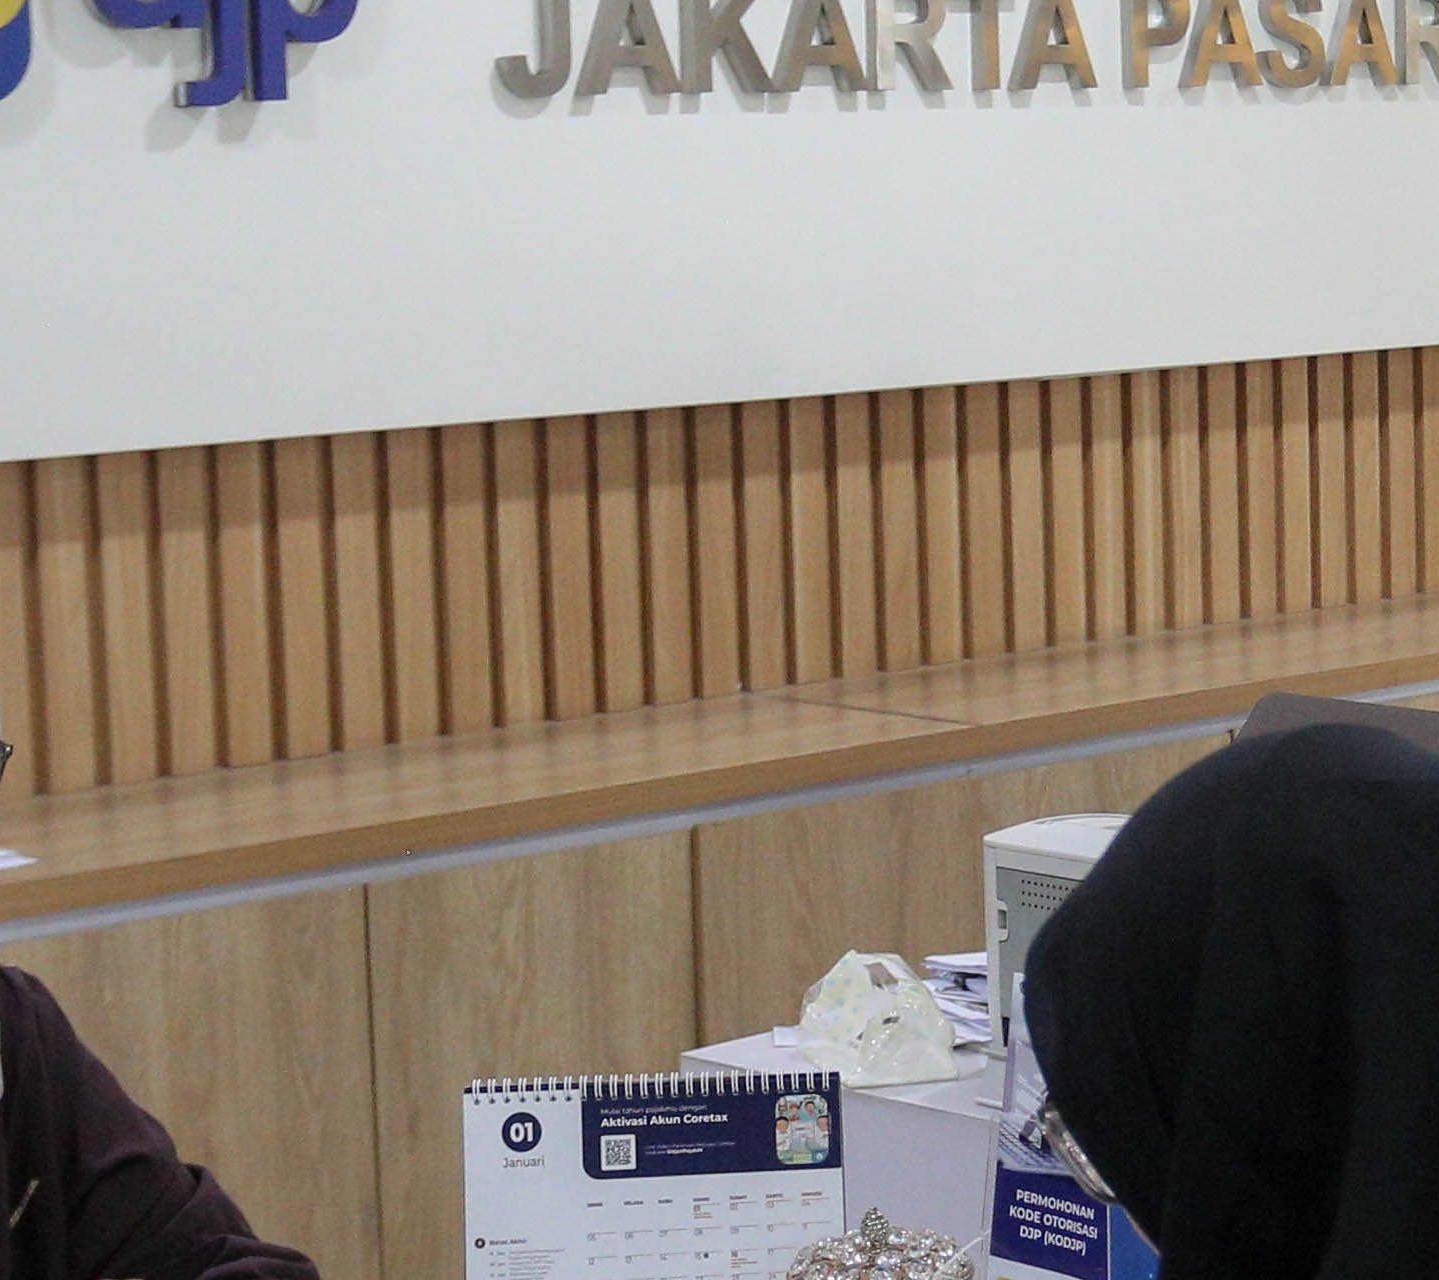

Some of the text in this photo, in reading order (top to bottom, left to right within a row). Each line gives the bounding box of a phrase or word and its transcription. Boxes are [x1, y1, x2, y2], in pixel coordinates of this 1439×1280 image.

[508, 1122, 536, 1143] 01
[601, 1113, 729, 1128] Aktivasi Akun Coretax
[502, 1154, 545, 1169] Januari
[1016, 1189, 1095, 1221] PERMOHONAN
[1009, 1205, 1098, 1239] KODE OTORISASI
[1020, 1225, 1087, 1256] DJP (KODJP)
